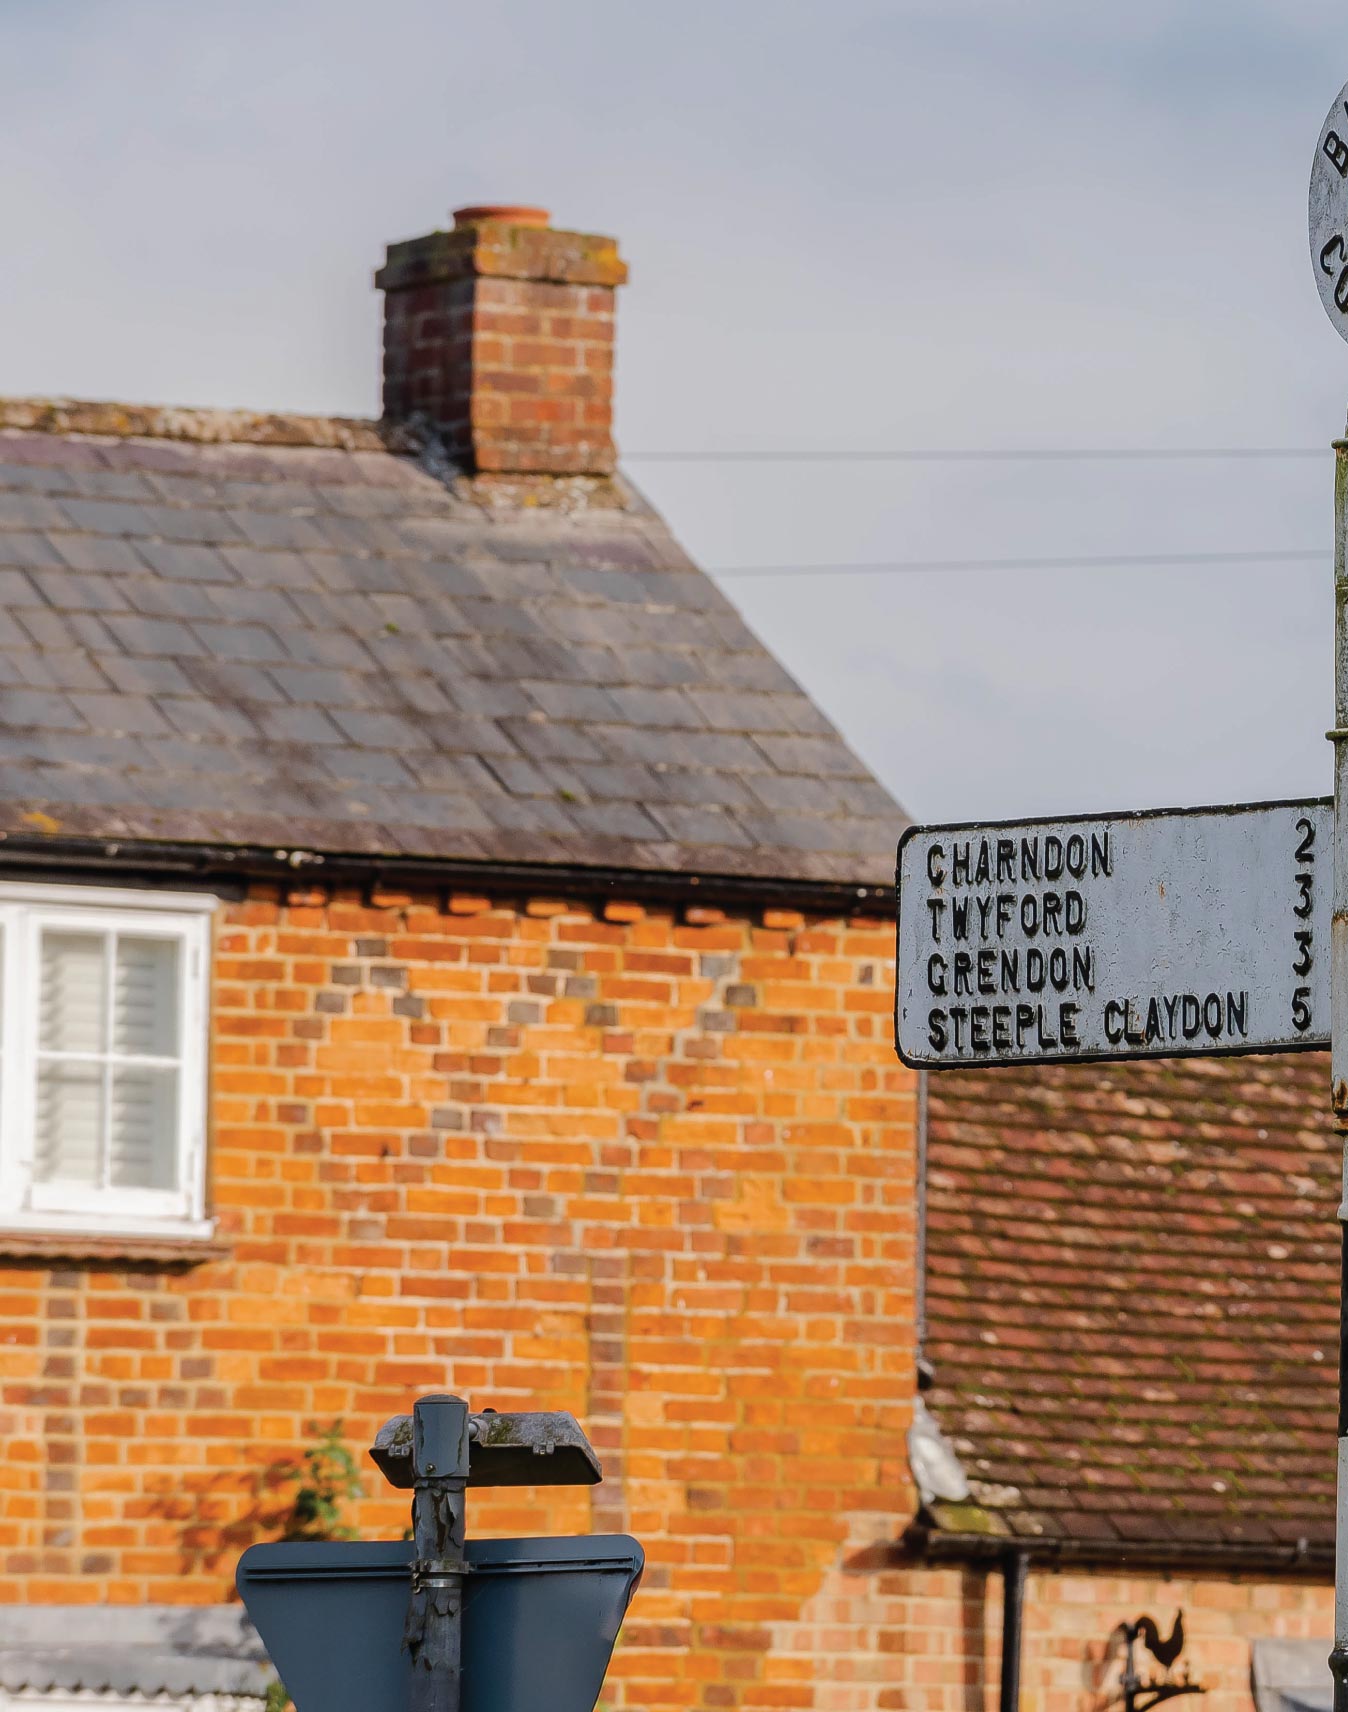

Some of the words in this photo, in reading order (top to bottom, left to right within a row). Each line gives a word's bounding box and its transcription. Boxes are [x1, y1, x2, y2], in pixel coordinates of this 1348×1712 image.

[926, 831, 1113, 887] CHARNDON
[1294, 817, 1316, 864] 2
[926, 890, 1087, 941] TWYFORD
[1293, 872, 1314, 919] 3
[926, 945, 1096, 997] GRENDON
[1292, 931, 1313, 977] 3
[927, 1002, 1082, 1052] STEEPLE
[1104, 991, 1249, 1045] CLAYDON
[1291, 987, 1312, 1031] 5
